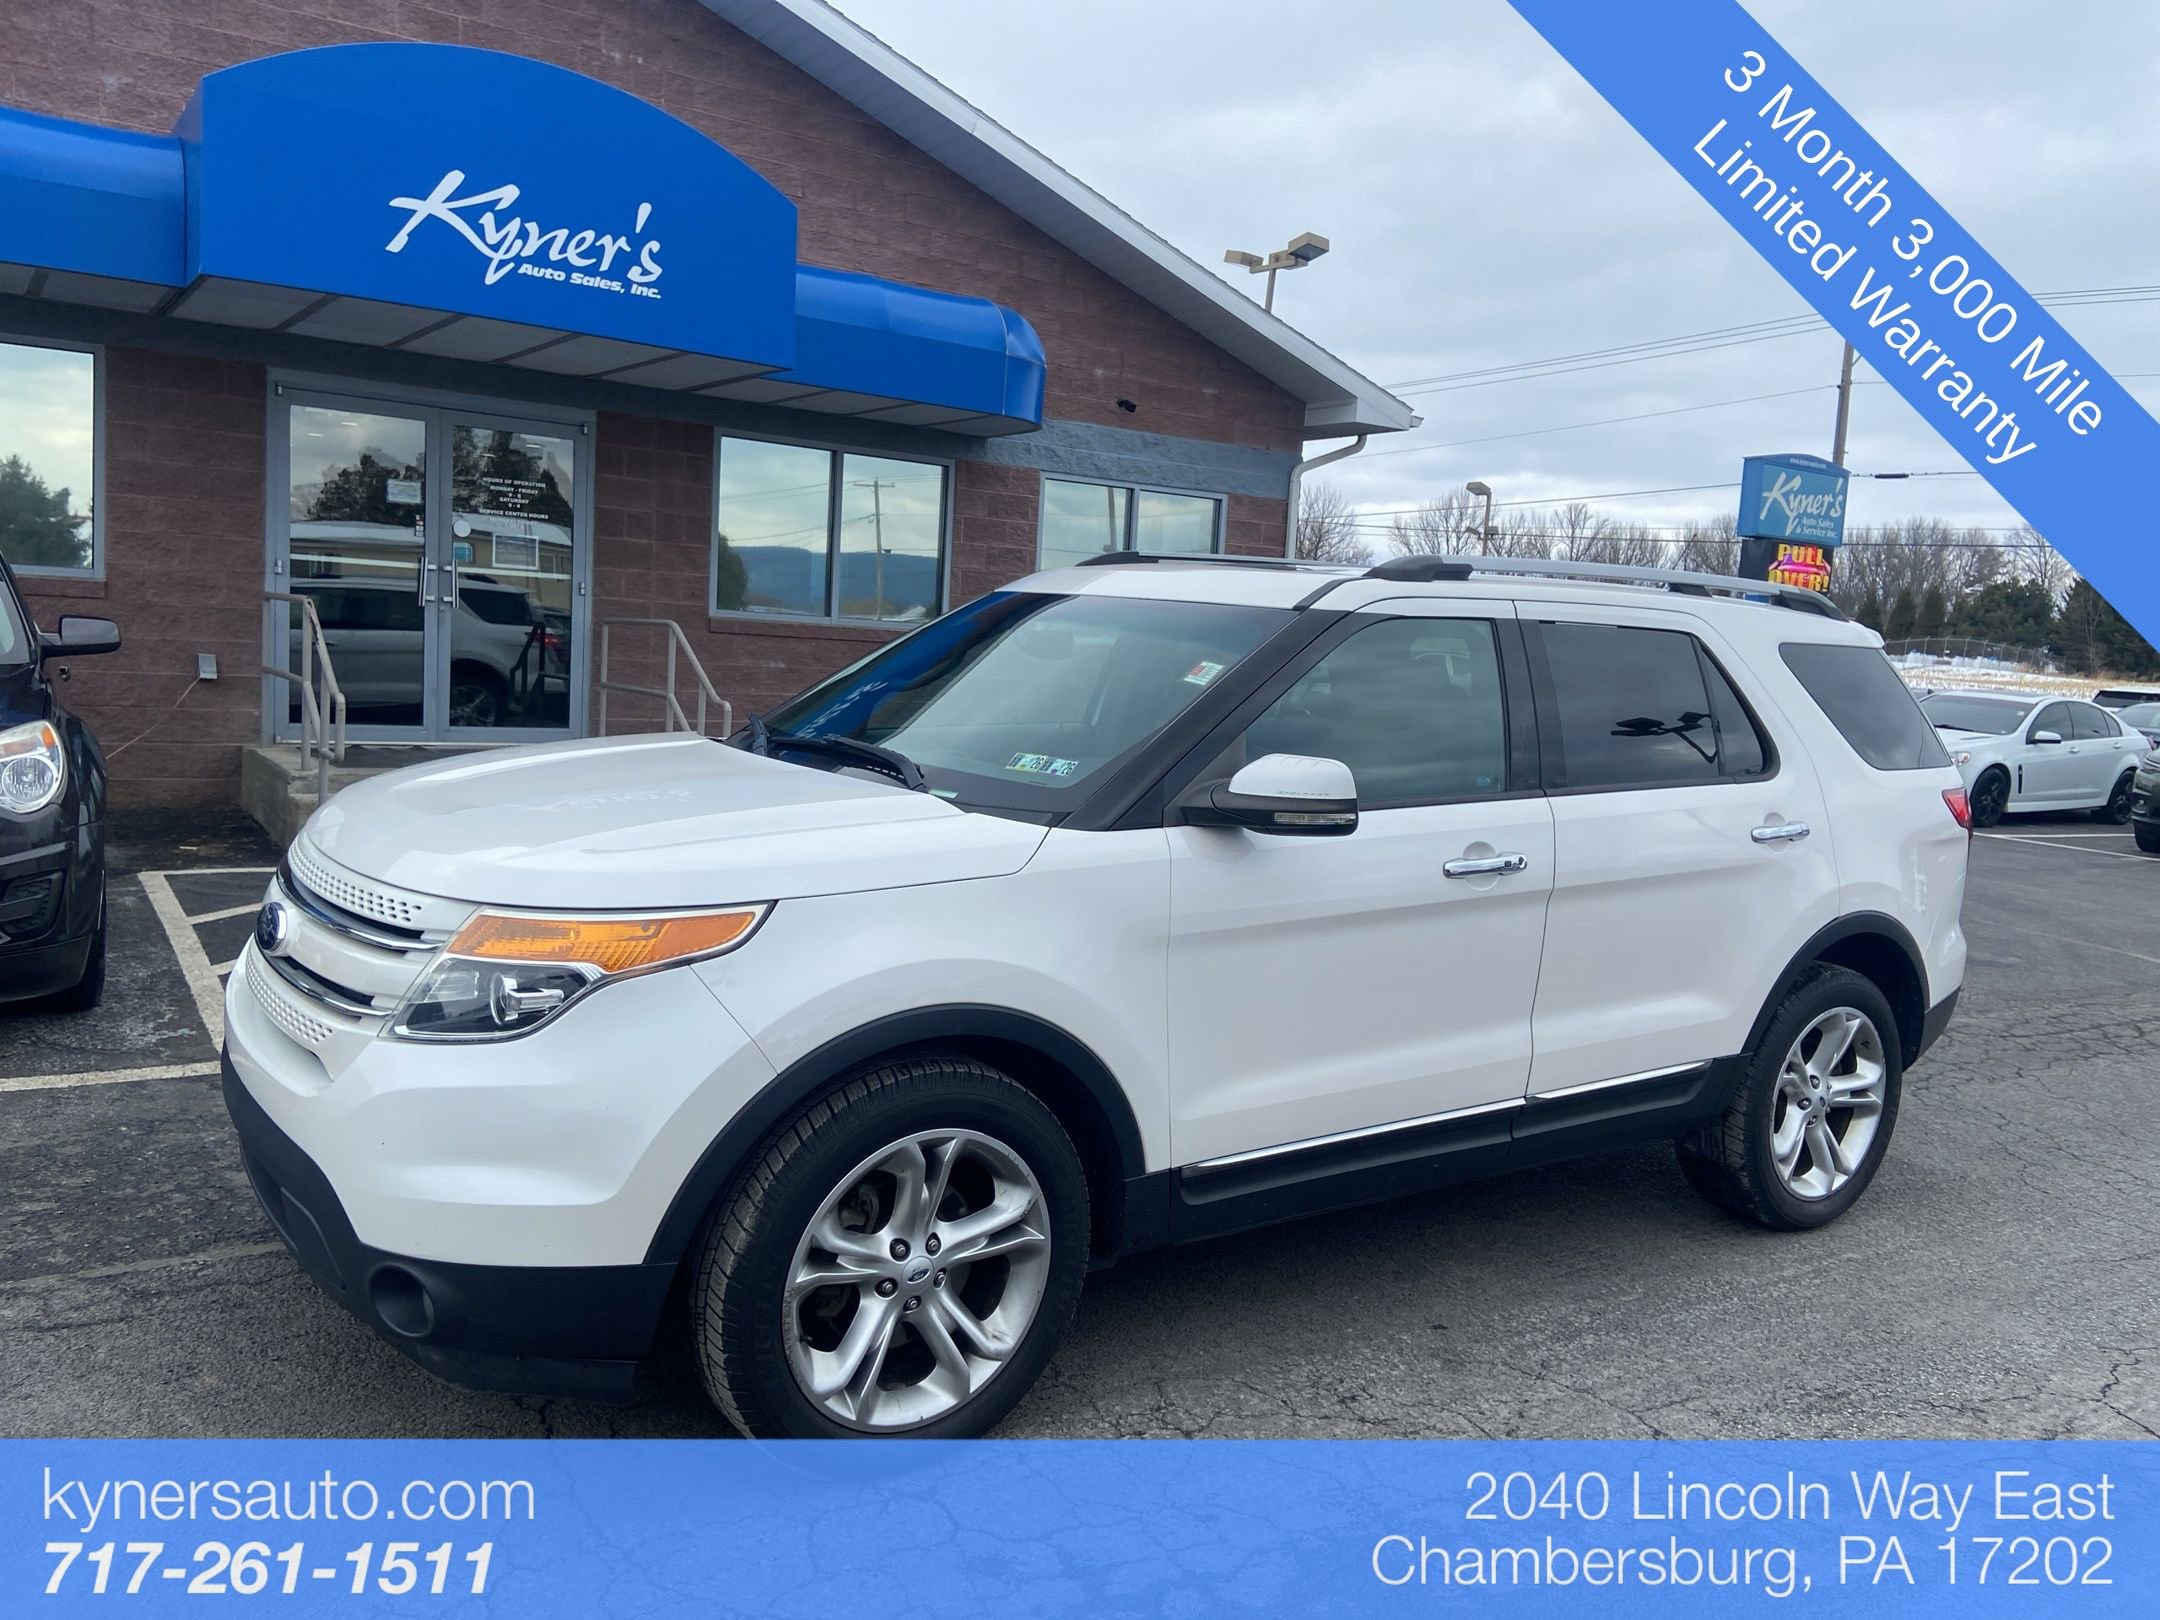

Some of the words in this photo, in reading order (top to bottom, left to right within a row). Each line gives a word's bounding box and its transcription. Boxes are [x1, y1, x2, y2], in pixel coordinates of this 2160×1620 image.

[385, 169, 662, 285] Kyner's
[518, 263, 566, 281] Auto
[570, 273, 625, 294] Sales,
[630, 283, 662, 299] Inc.
[1760, 472, 1843, 536] Kyner's
[1777, 543, 1824, 566] PULL
[1768, 569, 1829, 592] OVER!
